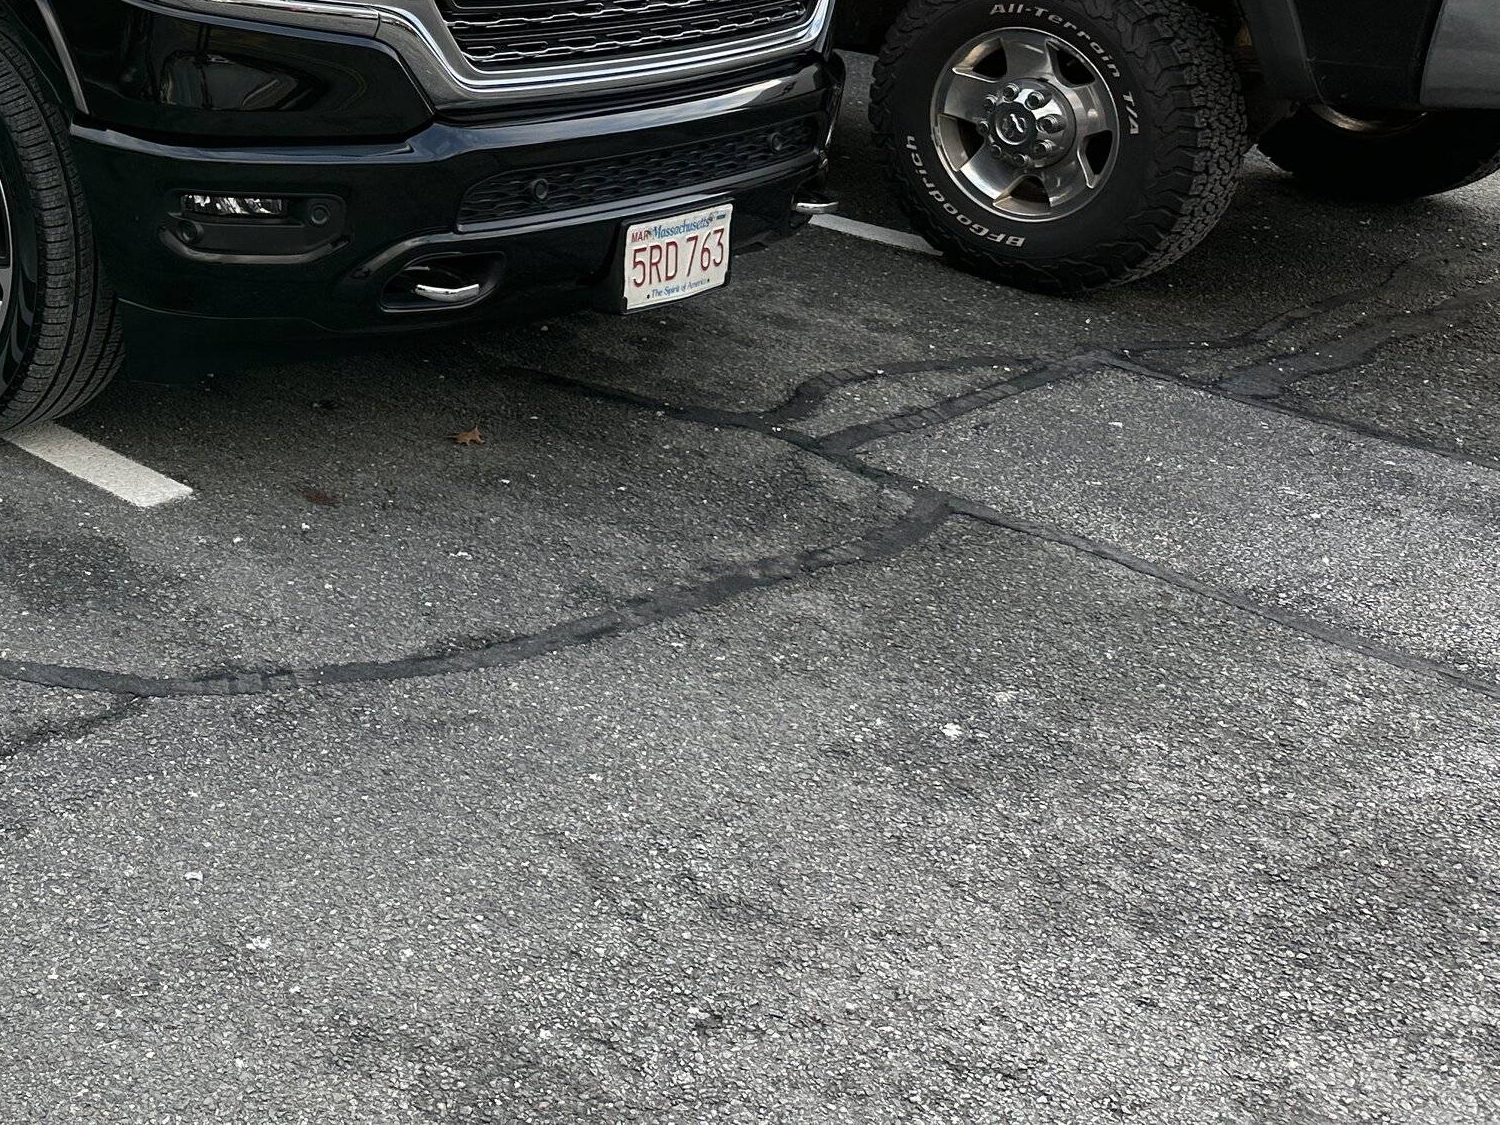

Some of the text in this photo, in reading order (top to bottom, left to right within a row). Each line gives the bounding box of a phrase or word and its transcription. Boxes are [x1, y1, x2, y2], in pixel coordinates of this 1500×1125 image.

[989, 2, 1140, 136] All-Terrain T/A
[905, 134, 1027, 249] BFGoodrich
[631, 217, 710, 243] MAR Massachusetts
[632, 227, 725, 288] 5RD 763
[663, 285, 680, 296] Spirit
